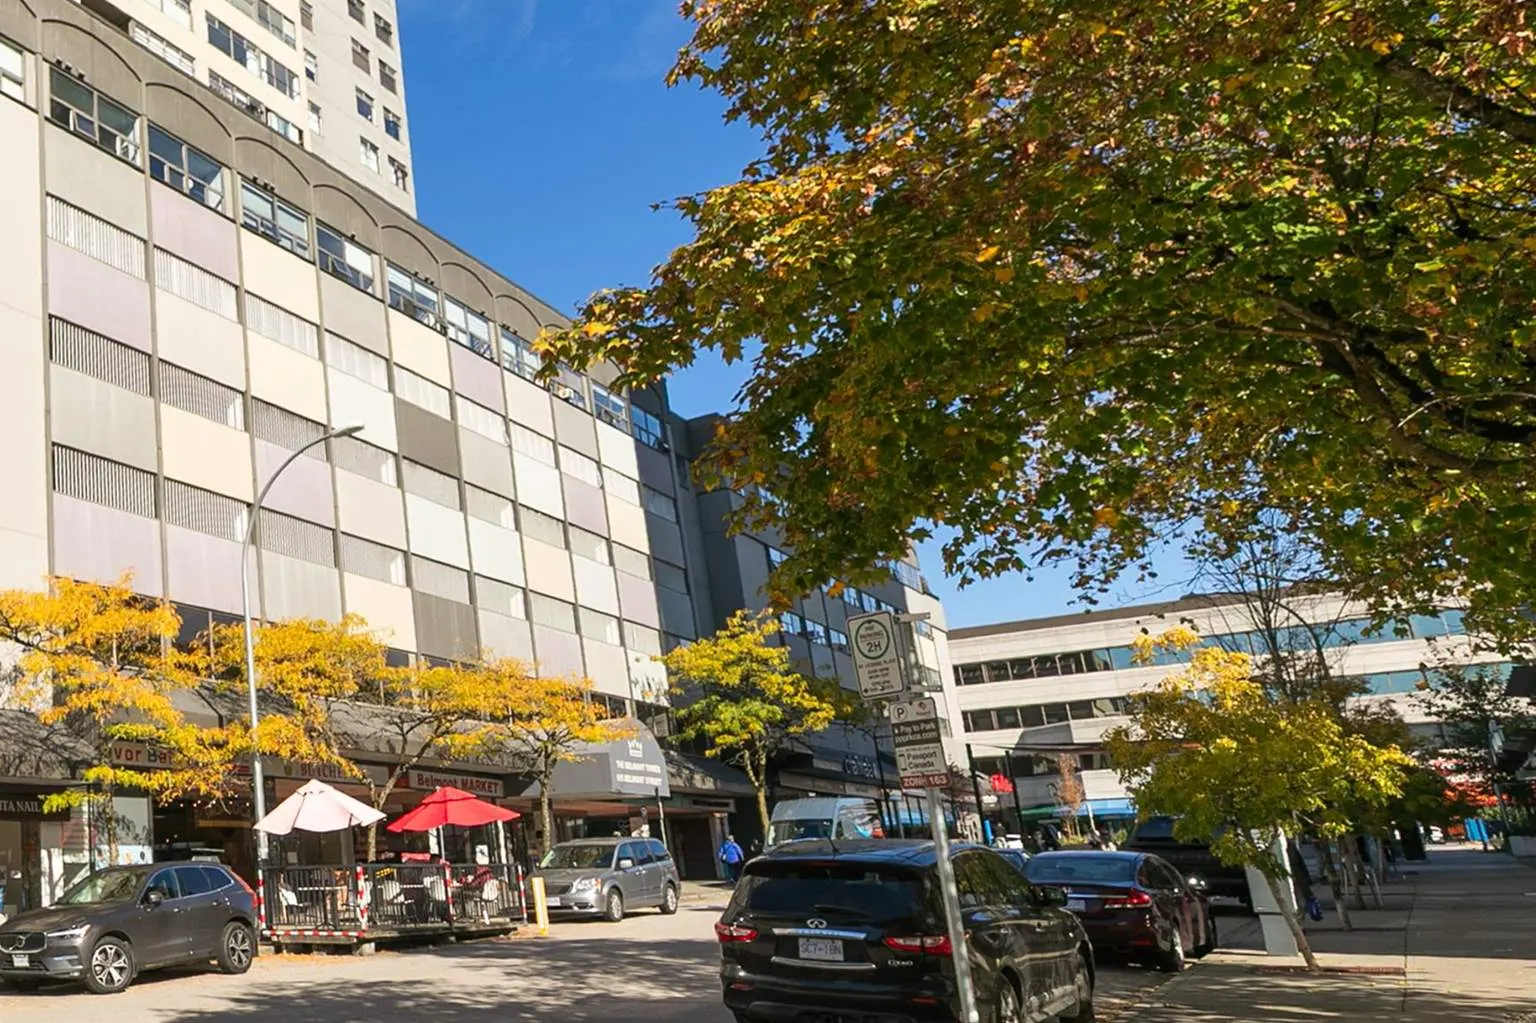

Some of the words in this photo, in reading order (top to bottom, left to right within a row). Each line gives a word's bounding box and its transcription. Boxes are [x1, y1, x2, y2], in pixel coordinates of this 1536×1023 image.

[866, 640, 882, 653] 2H
[900, 725, 912, 736] Pay
[920, 721, 936, 730] Park
[907, 751, 936, 761] Passport
[908, 761, 934, 769] Canada
[417, 773, 457, 787] Belmont
[461, 777, 498, 793] MARKET
[930, 775, 947, 784] 163
